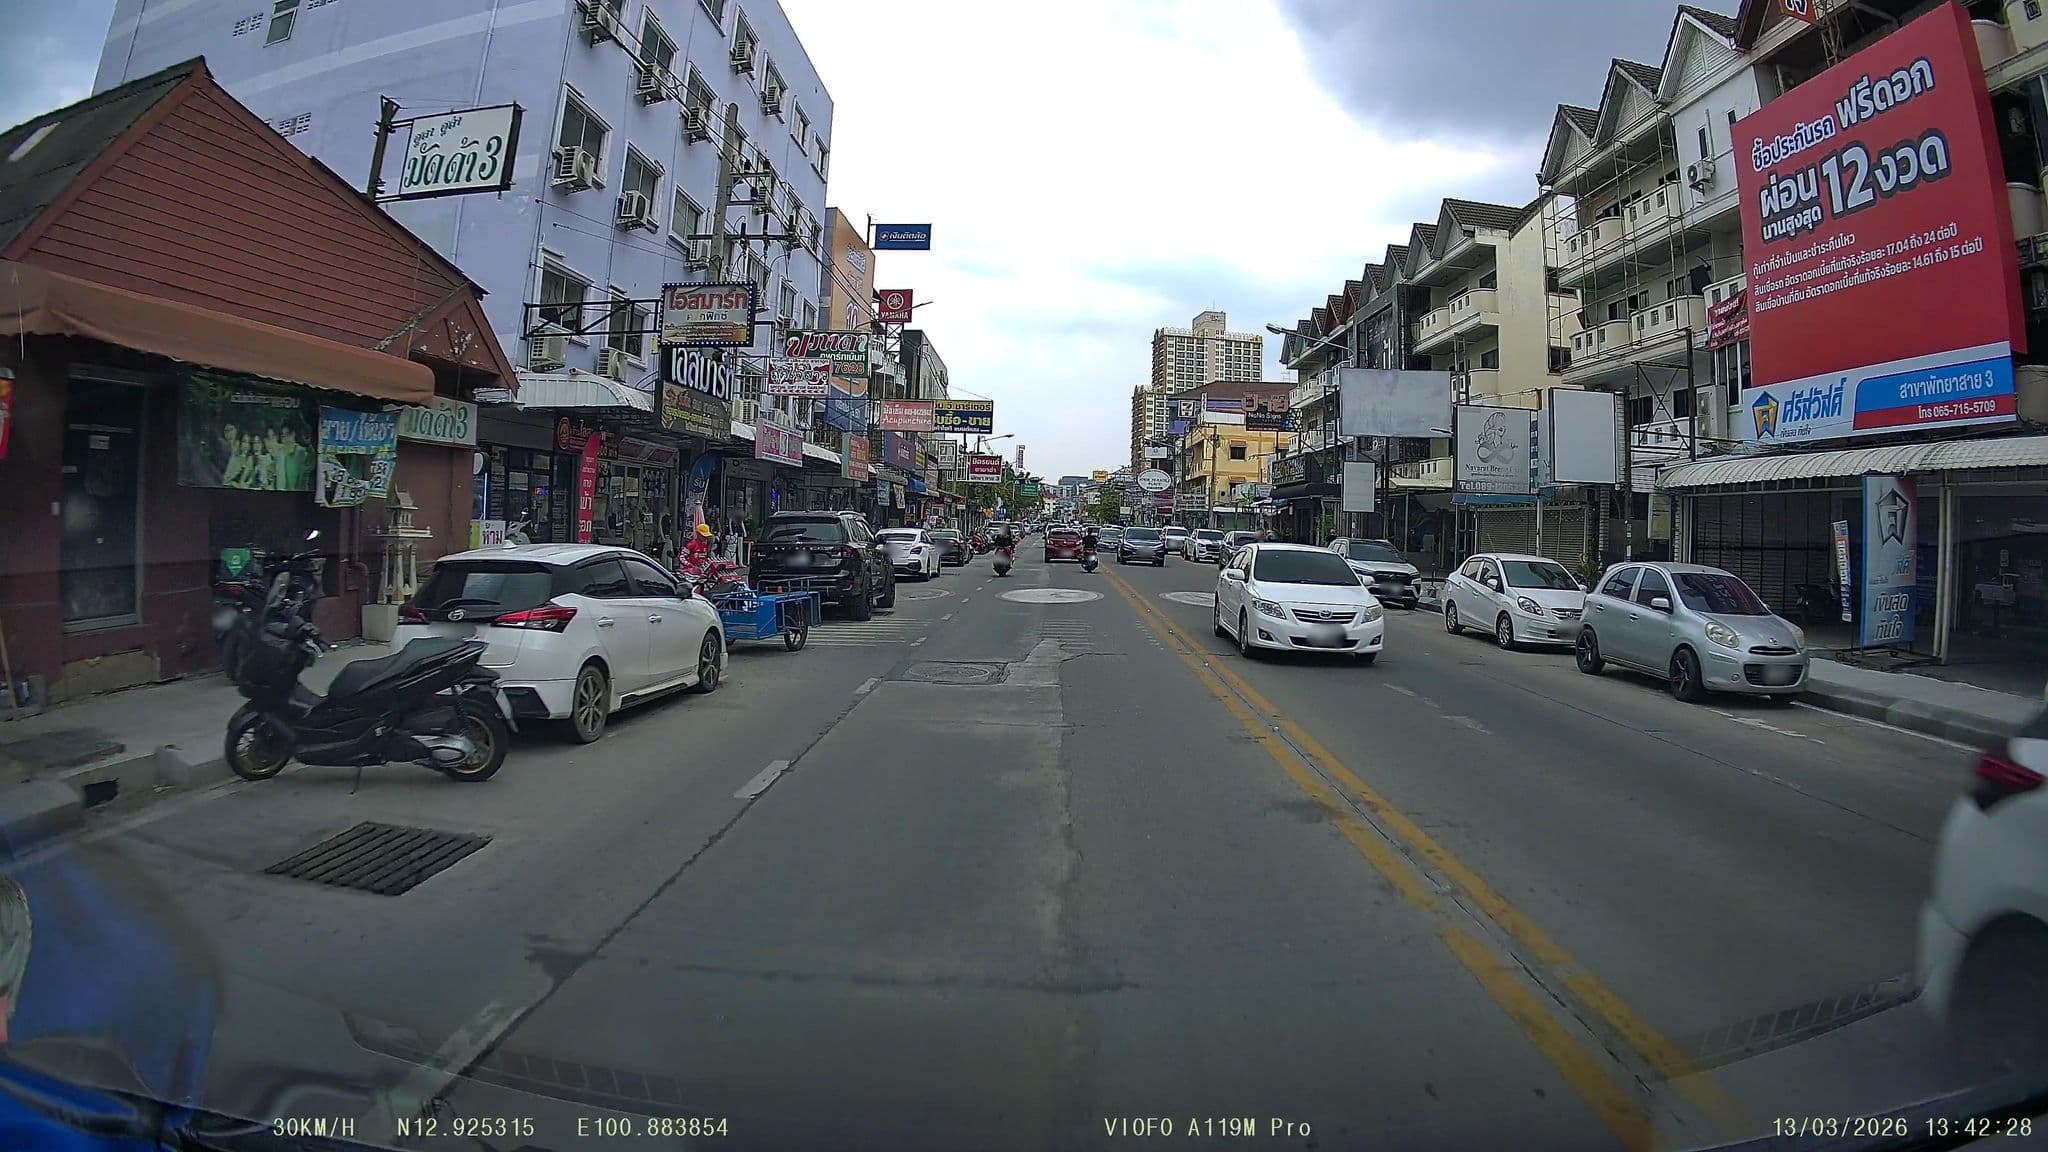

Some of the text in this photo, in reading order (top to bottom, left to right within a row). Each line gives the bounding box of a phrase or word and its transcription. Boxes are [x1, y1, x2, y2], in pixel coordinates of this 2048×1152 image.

[1836, 57, 1935, 129] ฟรีดอก
[1760, 135, 1949, 218] ผ่อน 12 งวด
[1763, 205, 1823, 241] นานสูงสุด
[1886, 239, 1909, 256] 17.04
[1922, 231, 1937, 246] 24
[1937, 222, 1959, 241] ต่อปี
[1912, 252, 1935, 270] 14.61
[1950, 244, 1962, 260] 15
[1962, 236, 1984, 255] ต่อปี
[881, 311, 909, 320] YAMAHA
[1984, 370, 1994, 388] 3
[881, 415, 932, 426] Acupuncture
[1933, 400, 1996, 418] 065-715-5709
